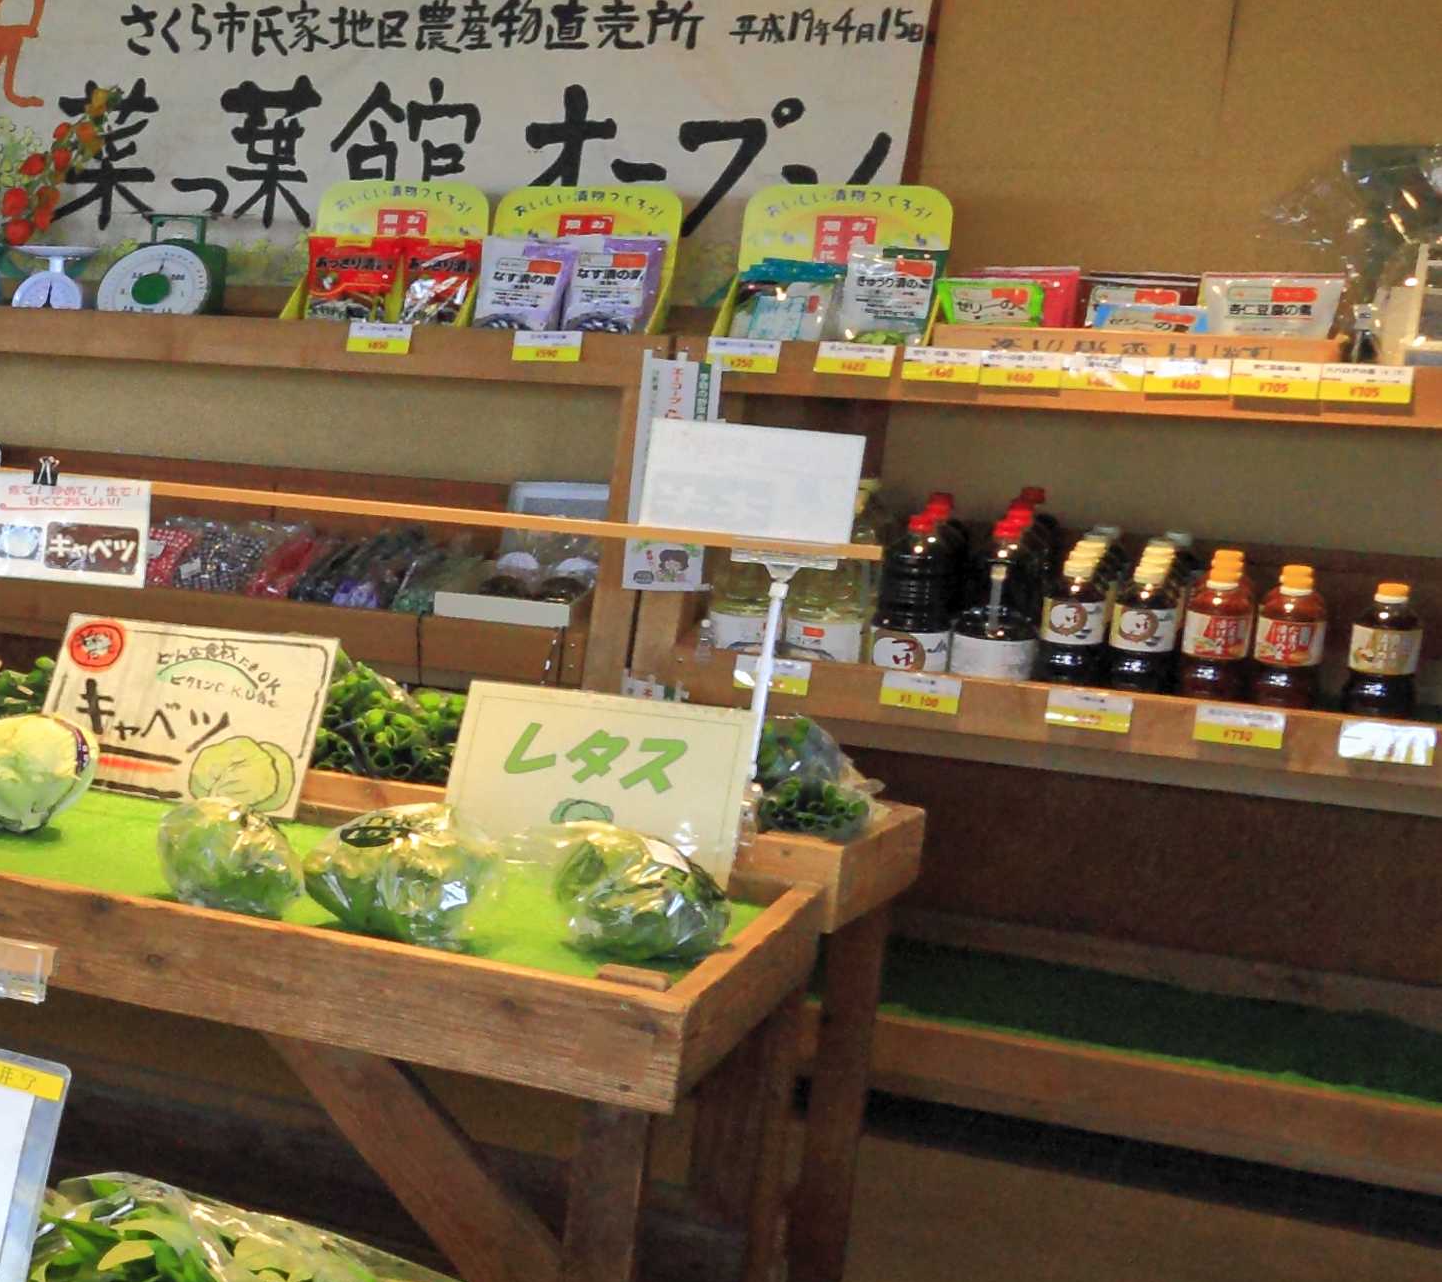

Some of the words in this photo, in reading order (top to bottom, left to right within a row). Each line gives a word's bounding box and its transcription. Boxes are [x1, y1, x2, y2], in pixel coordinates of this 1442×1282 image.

[729, 5, 924, 47] 平成19年4月15日
[52, 78, 482, 230] 菜っ葉館
[1259, 382, 1289, 394] ¥705
[1350, 387, 1380, 399] ¥705
[49, 533, 137, 564] キャベツ
[76, 678, 231, 753] キャベツ
[504, 722, 689, 795] レタス
